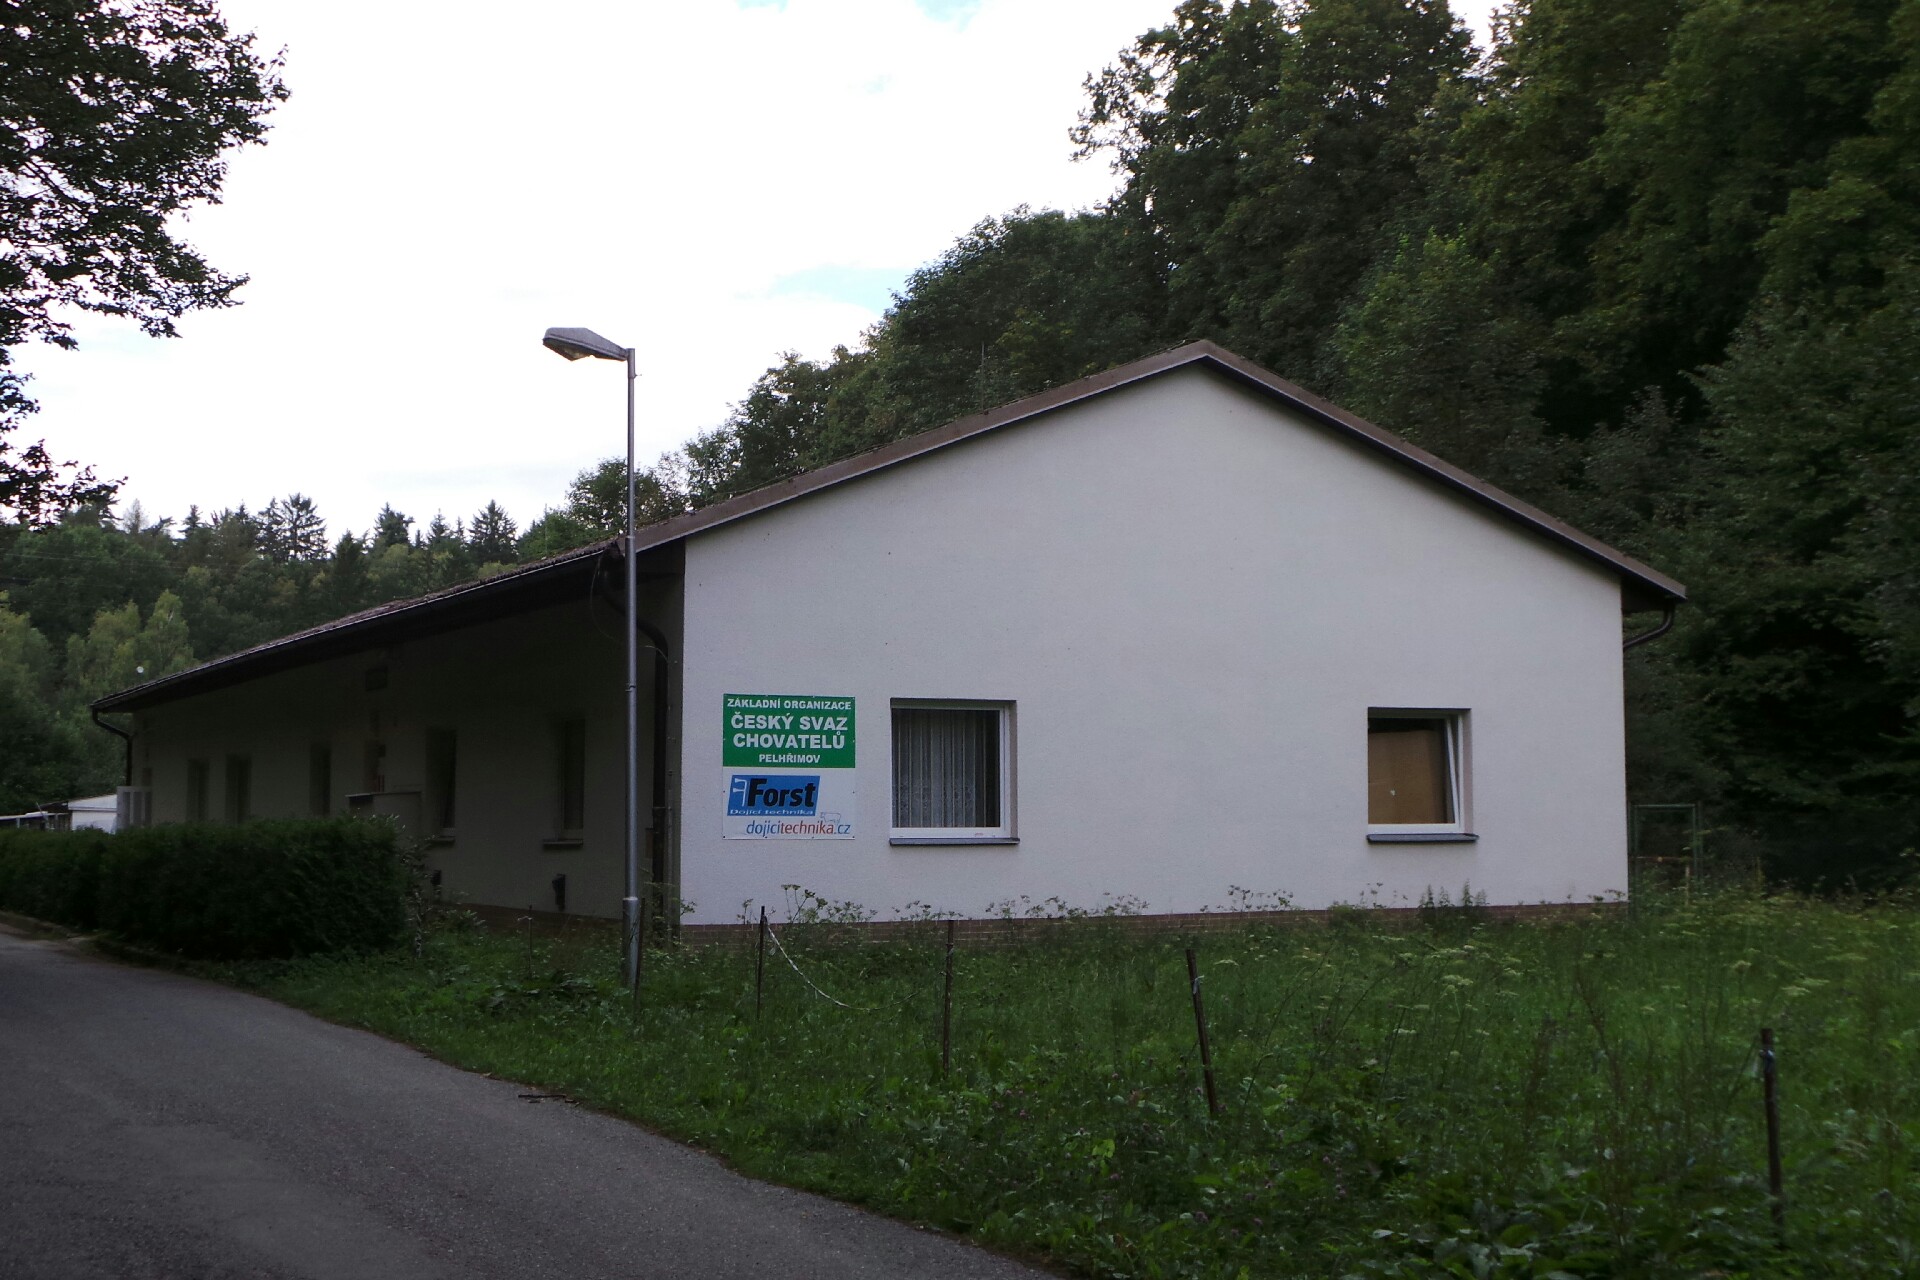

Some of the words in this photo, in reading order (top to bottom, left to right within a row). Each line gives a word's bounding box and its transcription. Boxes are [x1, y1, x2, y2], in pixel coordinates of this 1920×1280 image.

[727, 697, 780, 709] ZÁKLADNÍ
[784, 700, 852, 710] ORGANIZACE
[731, 711, 794, 730] ČESKÝ
[799, 716, 848, 731] SVAZ
[733, 731, 845, 749] CHOVATELŮ
[758, 753, 821, 764] PELHŘIMOV
[747, 778, 816, 808] Forst
[746, 820, 851, 838] dojicitechnika.cz
